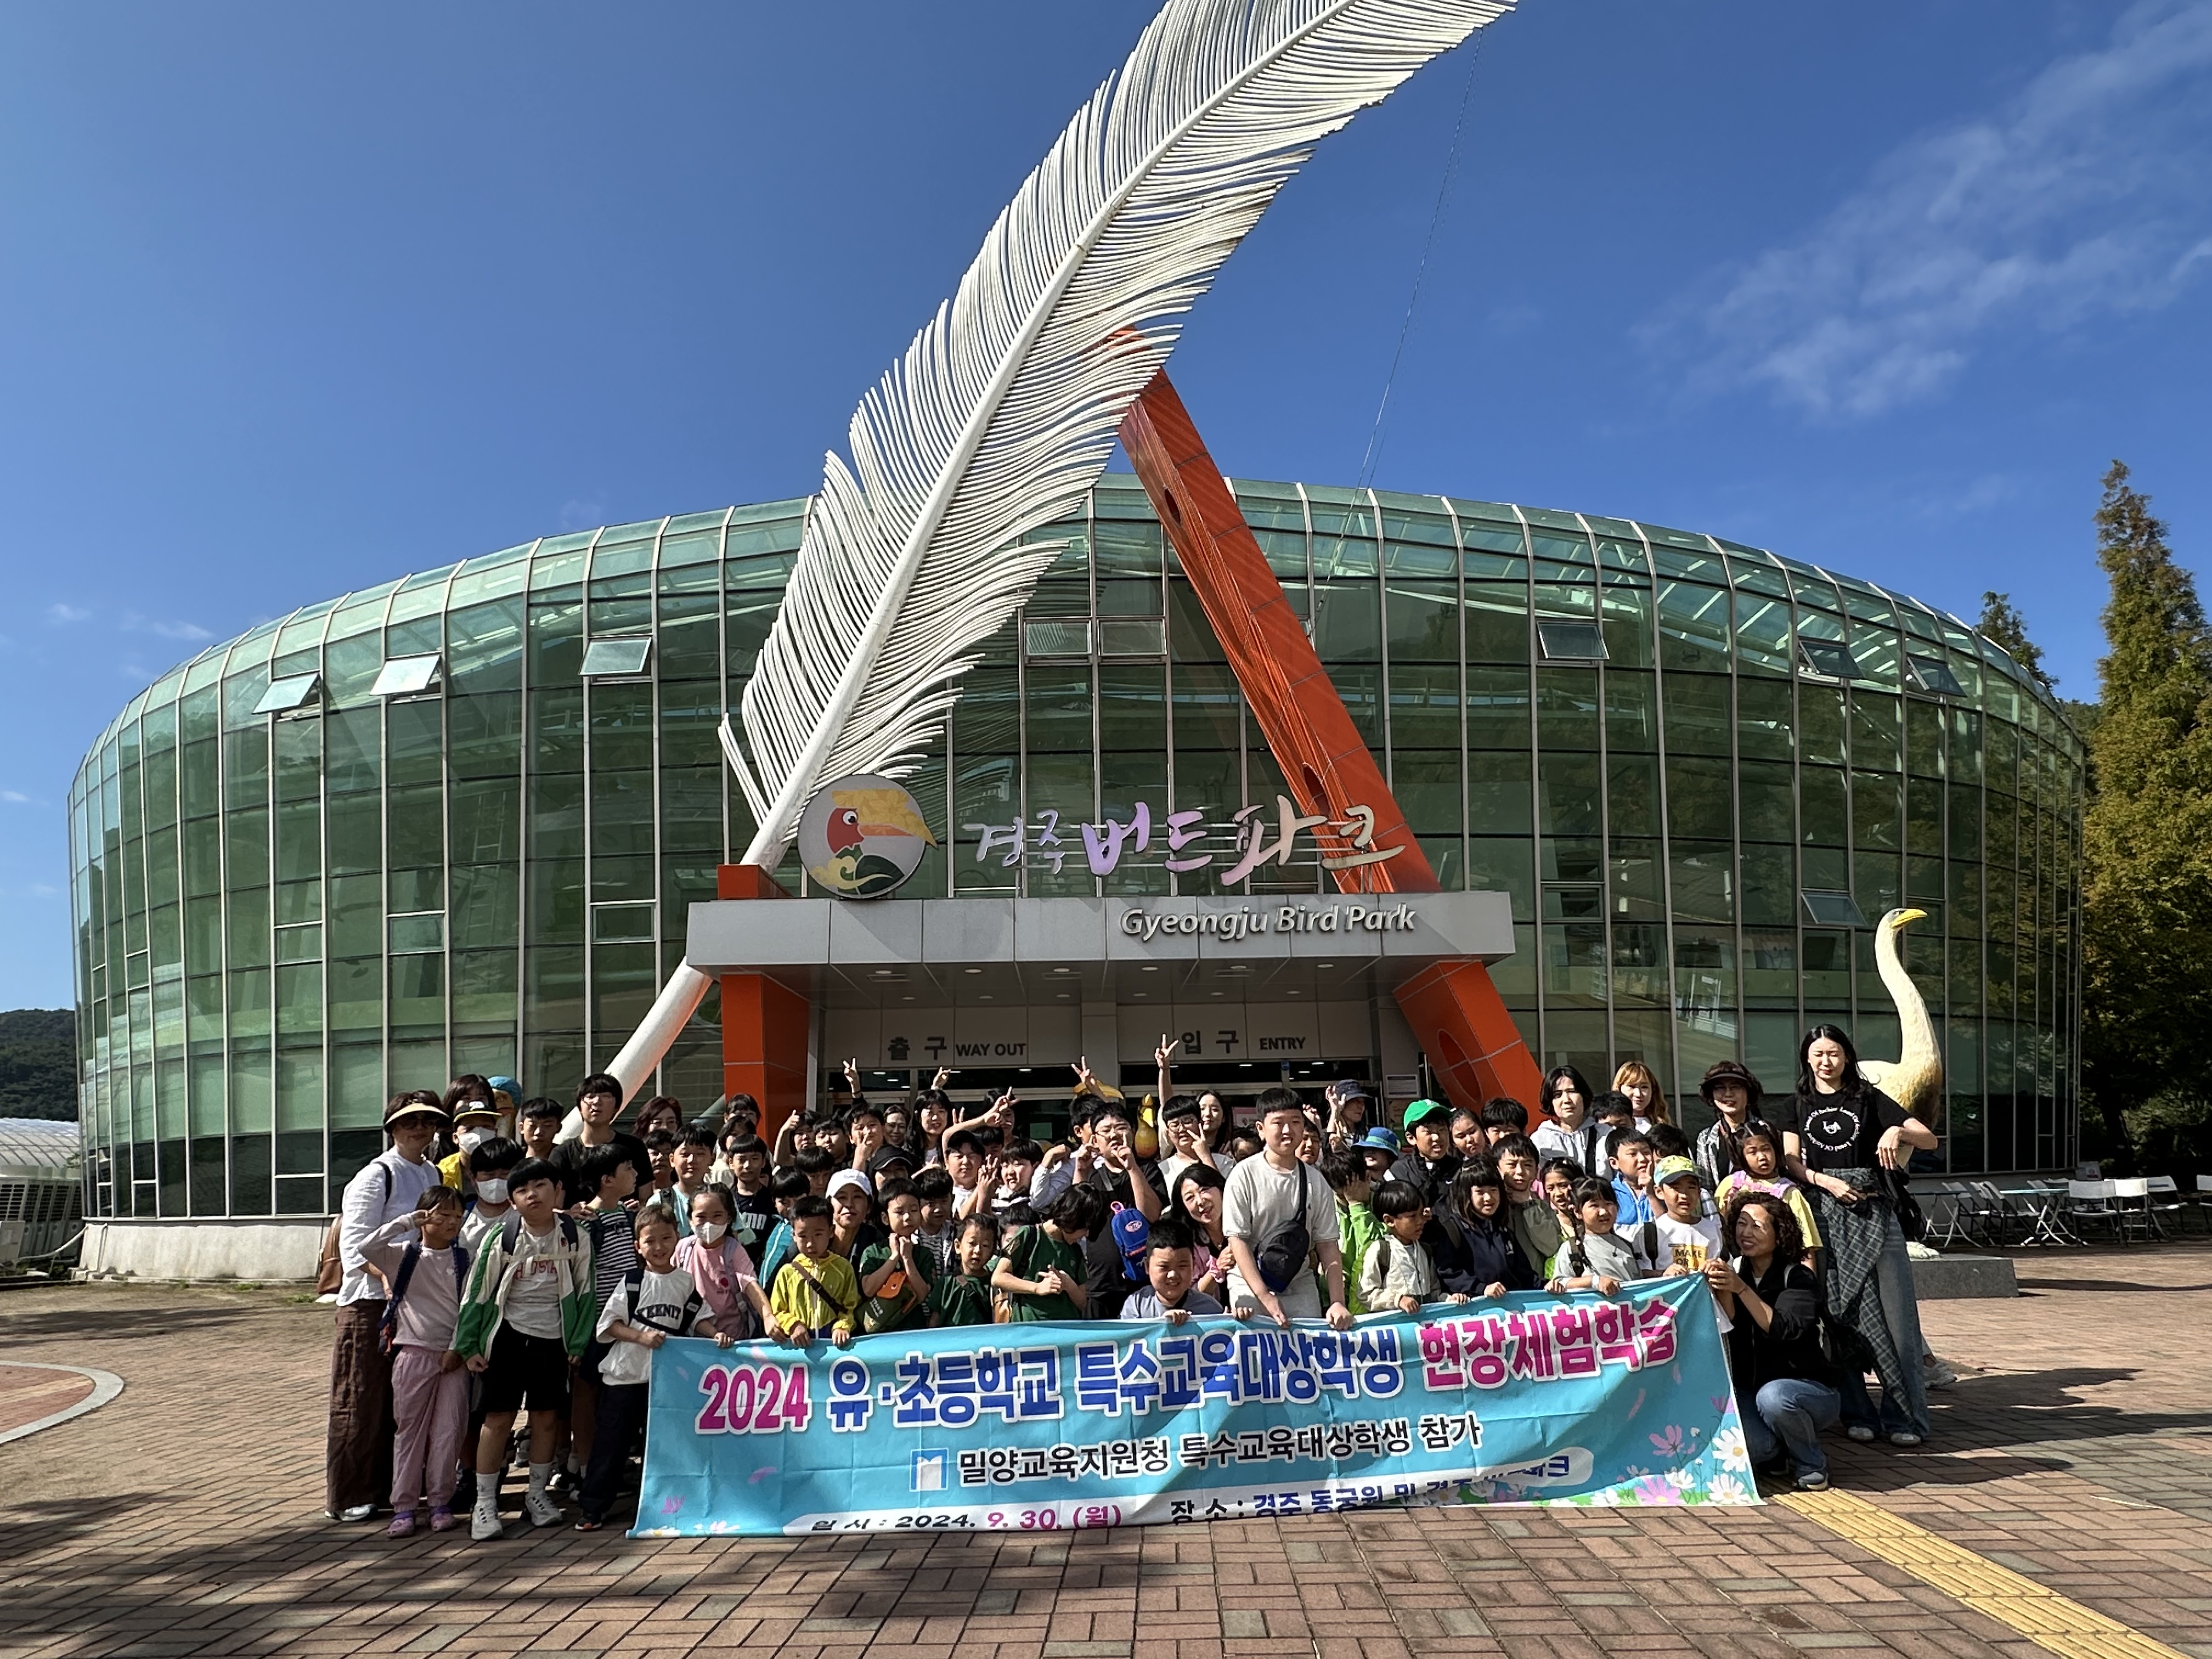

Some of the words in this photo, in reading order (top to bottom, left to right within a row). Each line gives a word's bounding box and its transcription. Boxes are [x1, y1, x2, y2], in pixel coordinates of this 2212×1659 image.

[962, 809, 1065, 875] 경주
[1080, 794, 1406, 887] 버드파크
[1120, 906, 1268, 941] Gyeongju
[1276, 904, 1339, 933] Bird
[1345, 902, 1418, 931] Park
[955, 1043, 990, 1057] WAY
[994, 1042, 1027, 1057] OUT
[1259, 1036, 1306, 1051] ENTRY
[1674, 1249, 1703, 1259] MAKE
[697, 1364, 810, 1432] 2024
[828, 1345, 1062, 1429] 유·초등학교
[1077, 1327, 1402, 1414] 특수교육대상학생
[1419, 1299, 1675, 1389] 현장체험학습
[959, 1440, 1169, 1485] 밀양교육지원청
[1181, 1419, 1410, 1467] 특수교육대상학생
[1420, 1414, 1481, 1449] 참가
